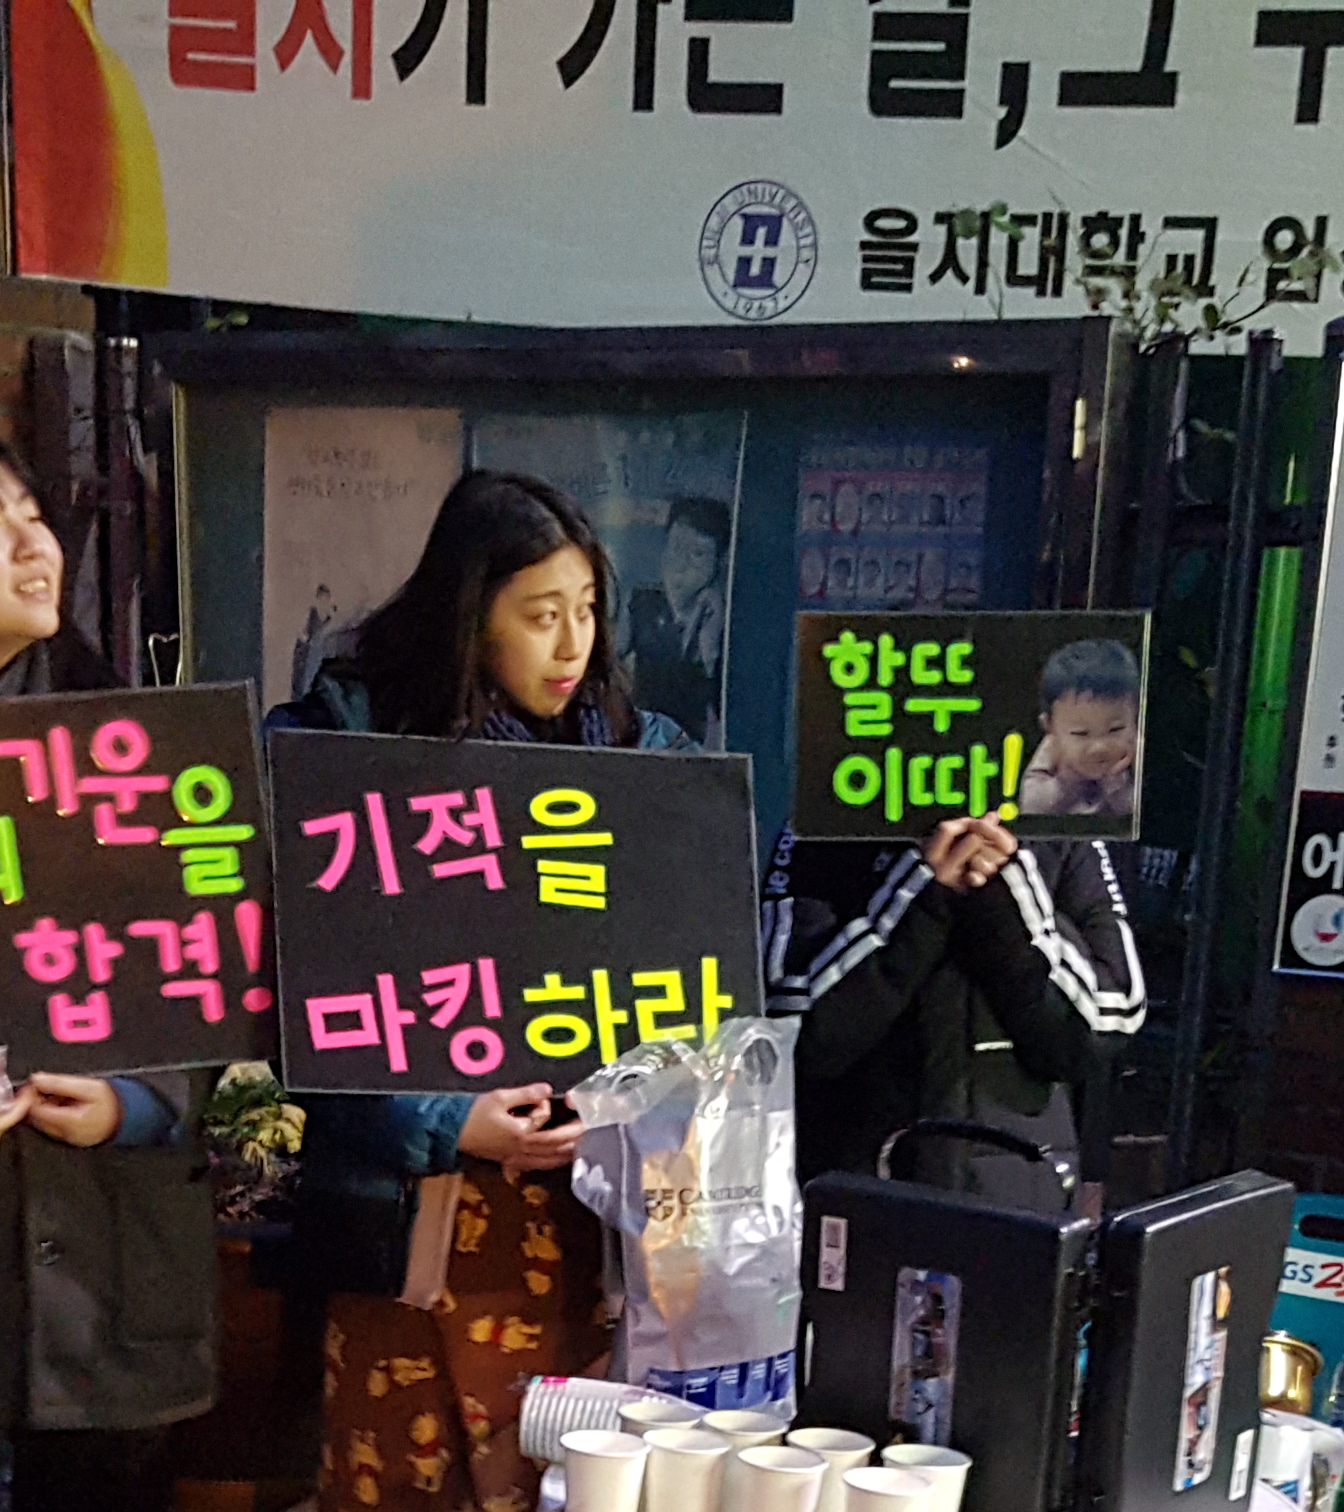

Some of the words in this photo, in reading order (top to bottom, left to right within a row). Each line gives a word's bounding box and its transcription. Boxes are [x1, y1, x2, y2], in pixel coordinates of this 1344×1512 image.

[823, 630, 982, 739] 할뚜
[831, 732, 1025, 822] 이따!
[14, 898, 275, 1043] 합격!
